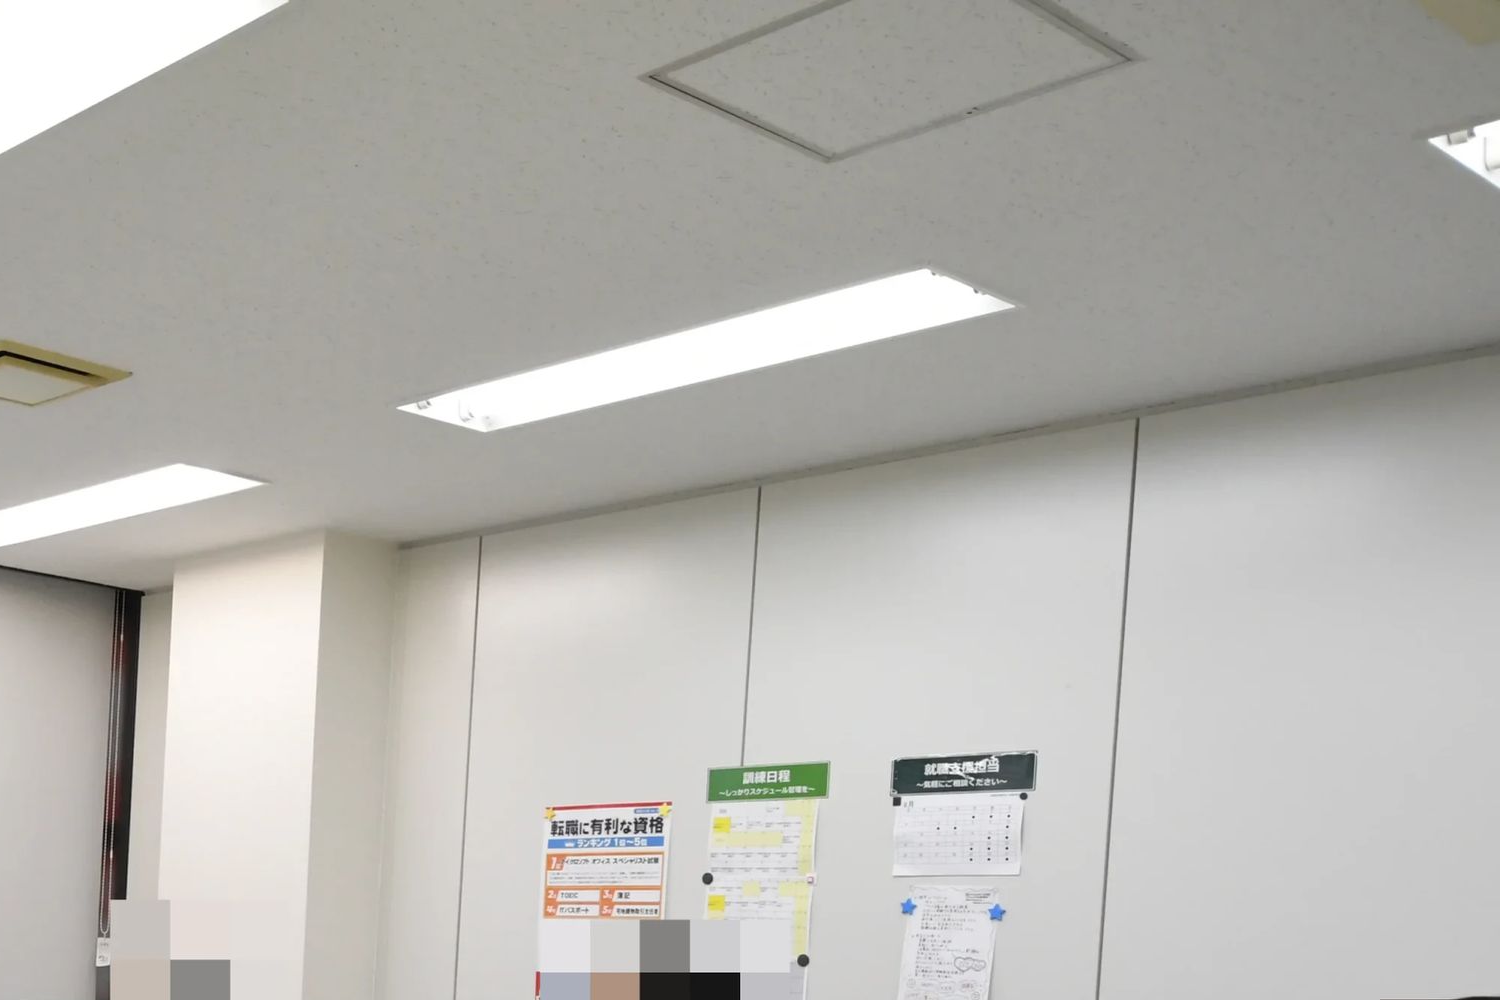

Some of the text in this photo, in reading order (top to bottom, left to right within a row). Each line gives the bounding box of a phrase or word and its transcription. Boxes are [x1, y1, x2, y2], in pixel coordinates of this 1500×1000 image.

[742, 769, 791, 785] 訓練日程
[550, 816, 664, 837] 転職に有利な資格
